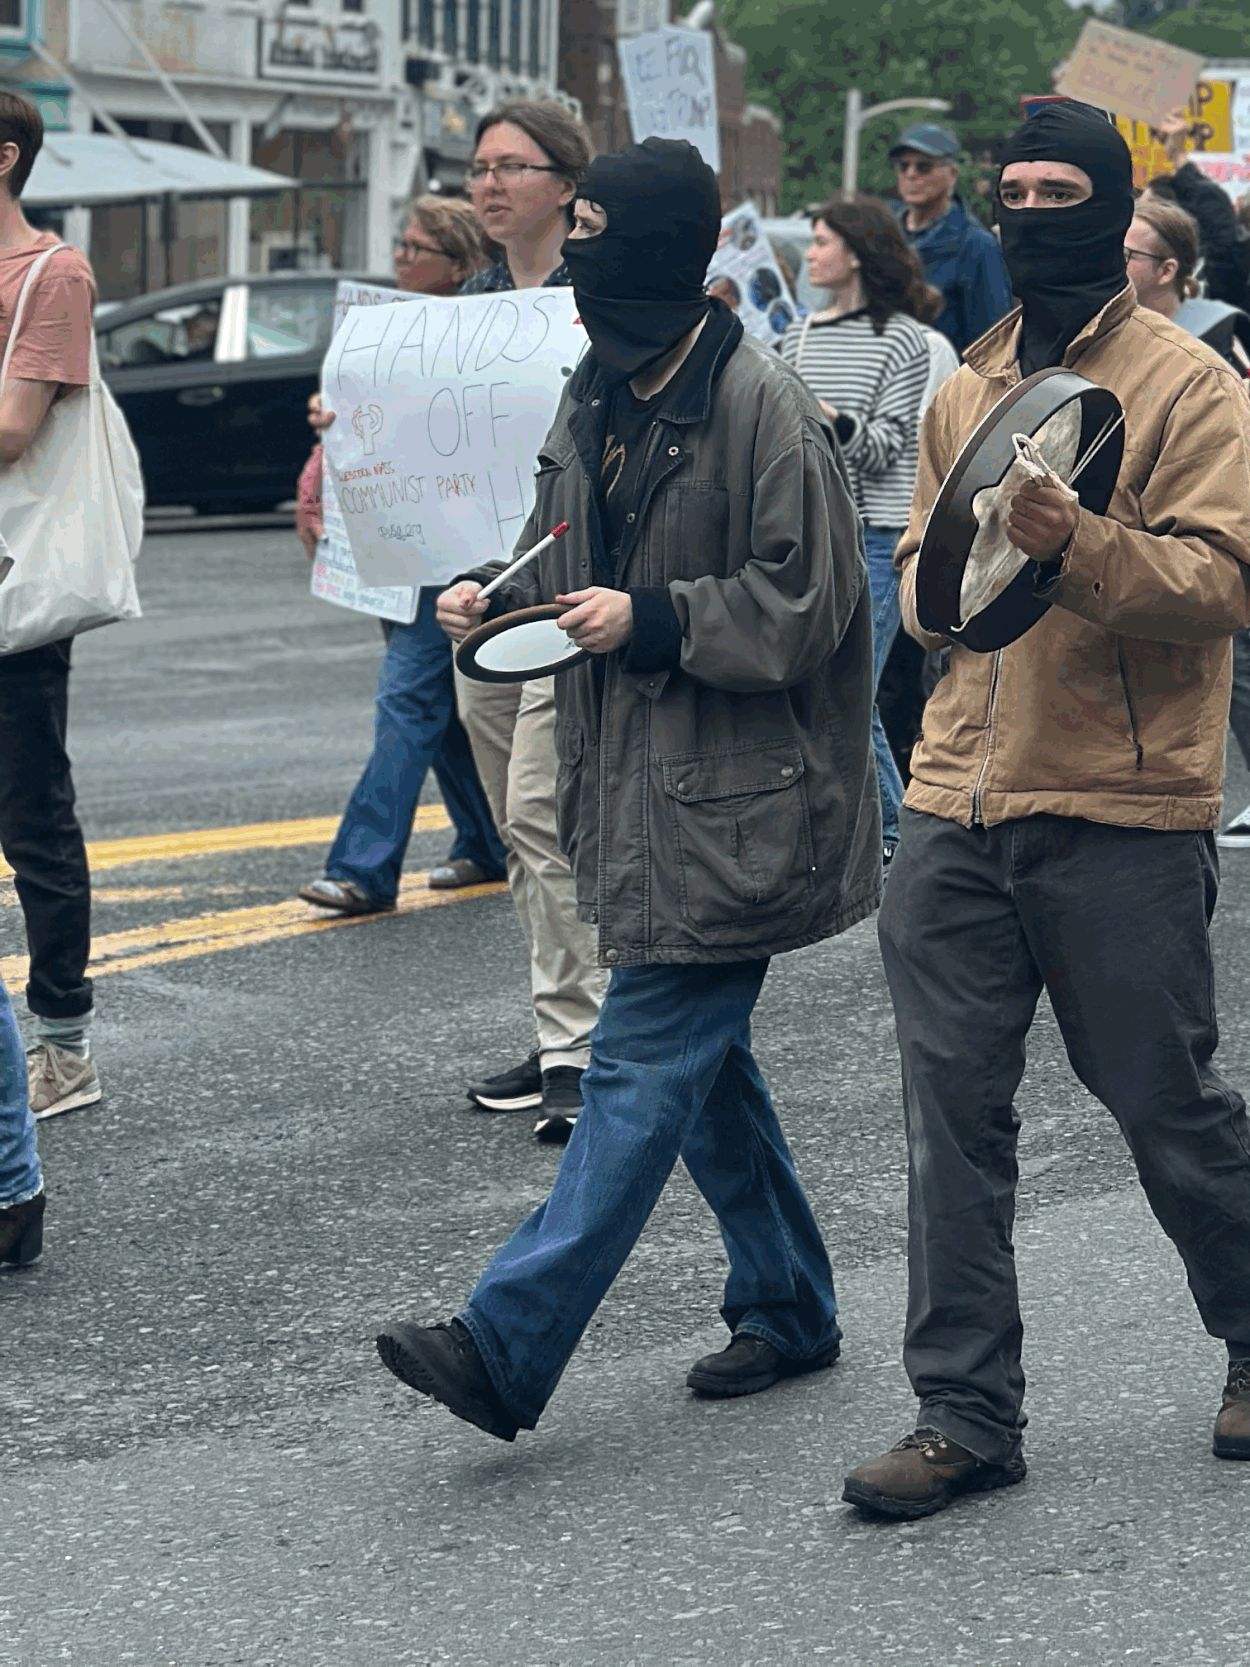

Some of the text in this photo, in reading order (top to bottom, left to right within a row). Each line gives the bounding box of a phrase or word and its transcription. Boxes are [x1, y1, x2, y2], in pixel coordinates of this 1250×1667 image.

[337, 294, 557, 392] HANDS
[427, 381, 510, 457] OFF
[342, 472, 476, 514] COMMUNIST PARTY
